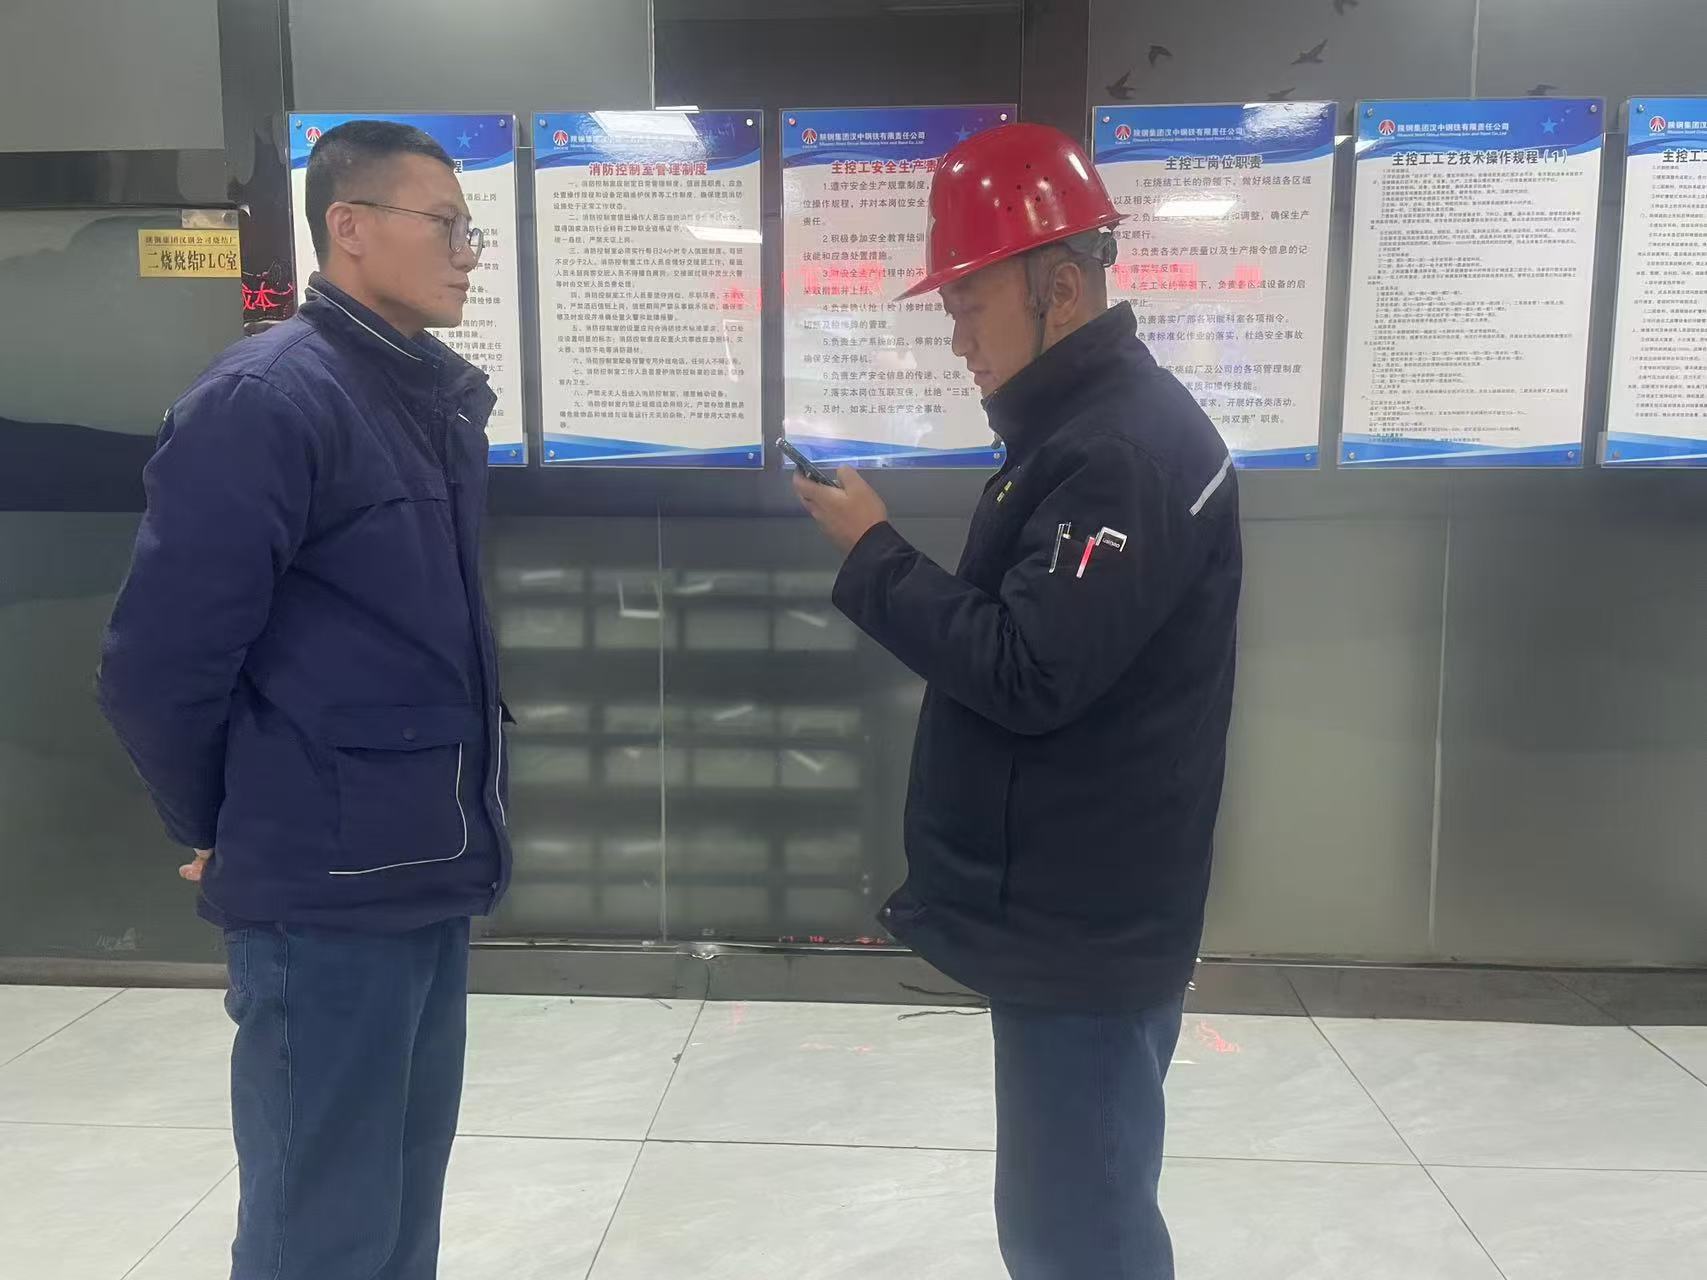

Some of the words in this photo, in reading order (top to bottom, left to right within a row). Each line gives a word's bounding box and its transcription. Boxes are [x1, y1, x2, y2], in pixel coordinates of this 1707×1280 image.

[1397, 122, 1509, 133] 陕钢集团汉中钢铁有限责任公司
[819, 131, 926, 141] 陕钢集团汉中钢铁有限责任公司
[1165, 155, 1264, 171] 主控工岗位职责
[1391, 149, 1568, 166] 主控工工艺技术操作规程（1）
[588, 161, 708, 176] 消防控制室管理制度
[147, 250, 238, 271] 二烧烧结PLC室
